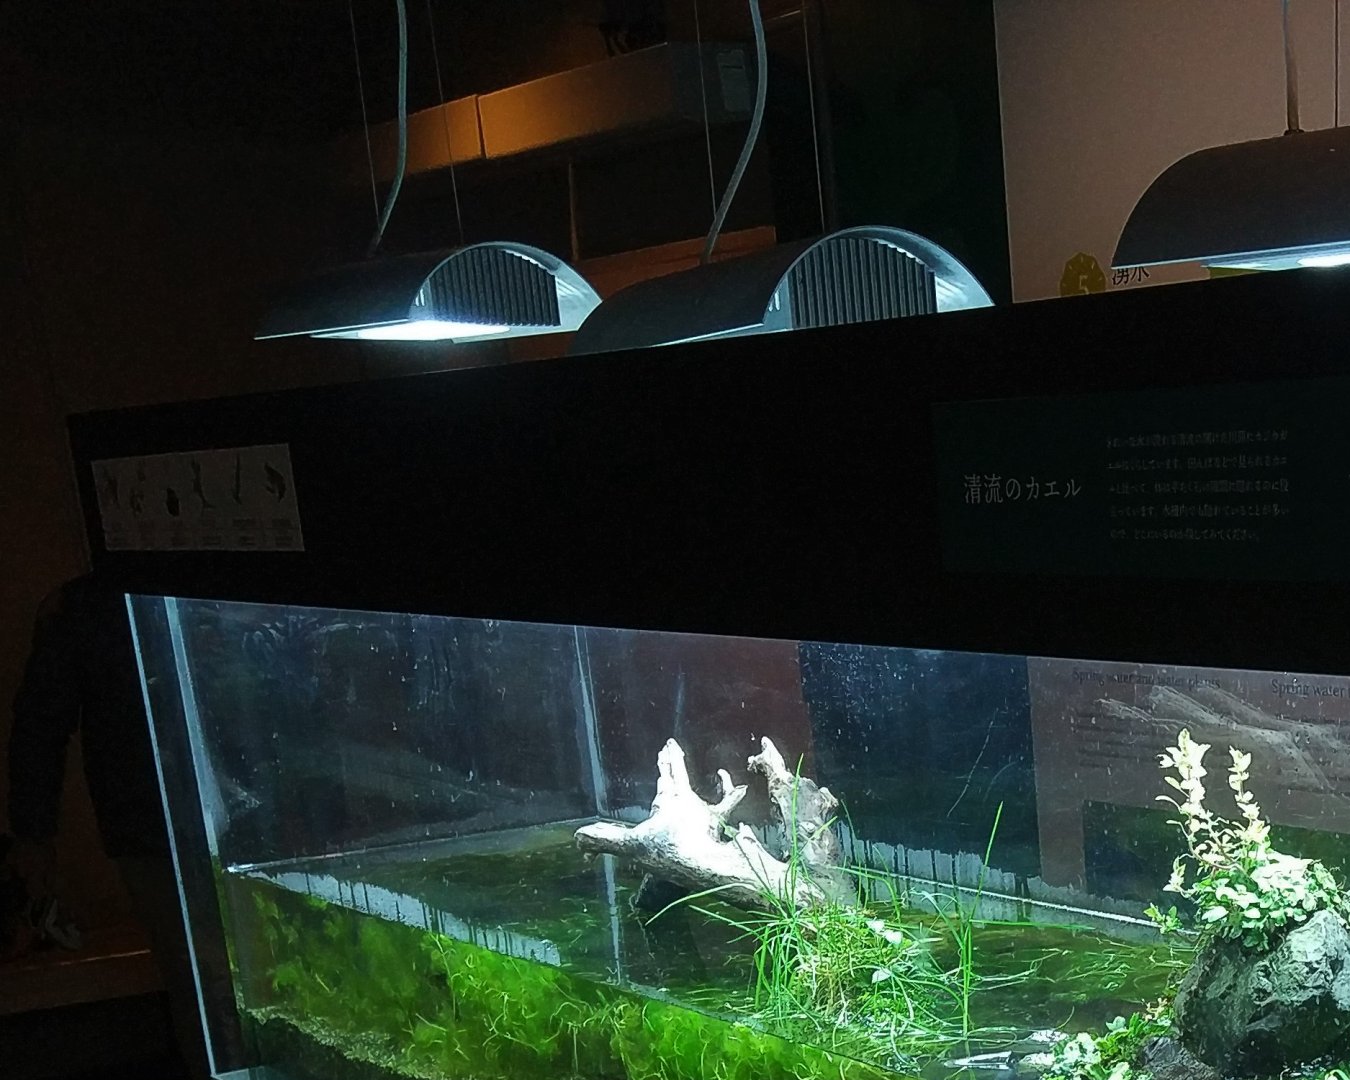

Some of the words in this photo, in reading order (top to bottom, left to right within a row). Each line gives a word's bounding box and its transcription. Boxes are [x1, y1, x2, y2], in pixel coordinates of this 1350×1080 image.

[963, 472, 1083, 504] 清流のカエル
[1271, 678, 1311, 700] Spring
[1313, 683, 1345, 699] water
